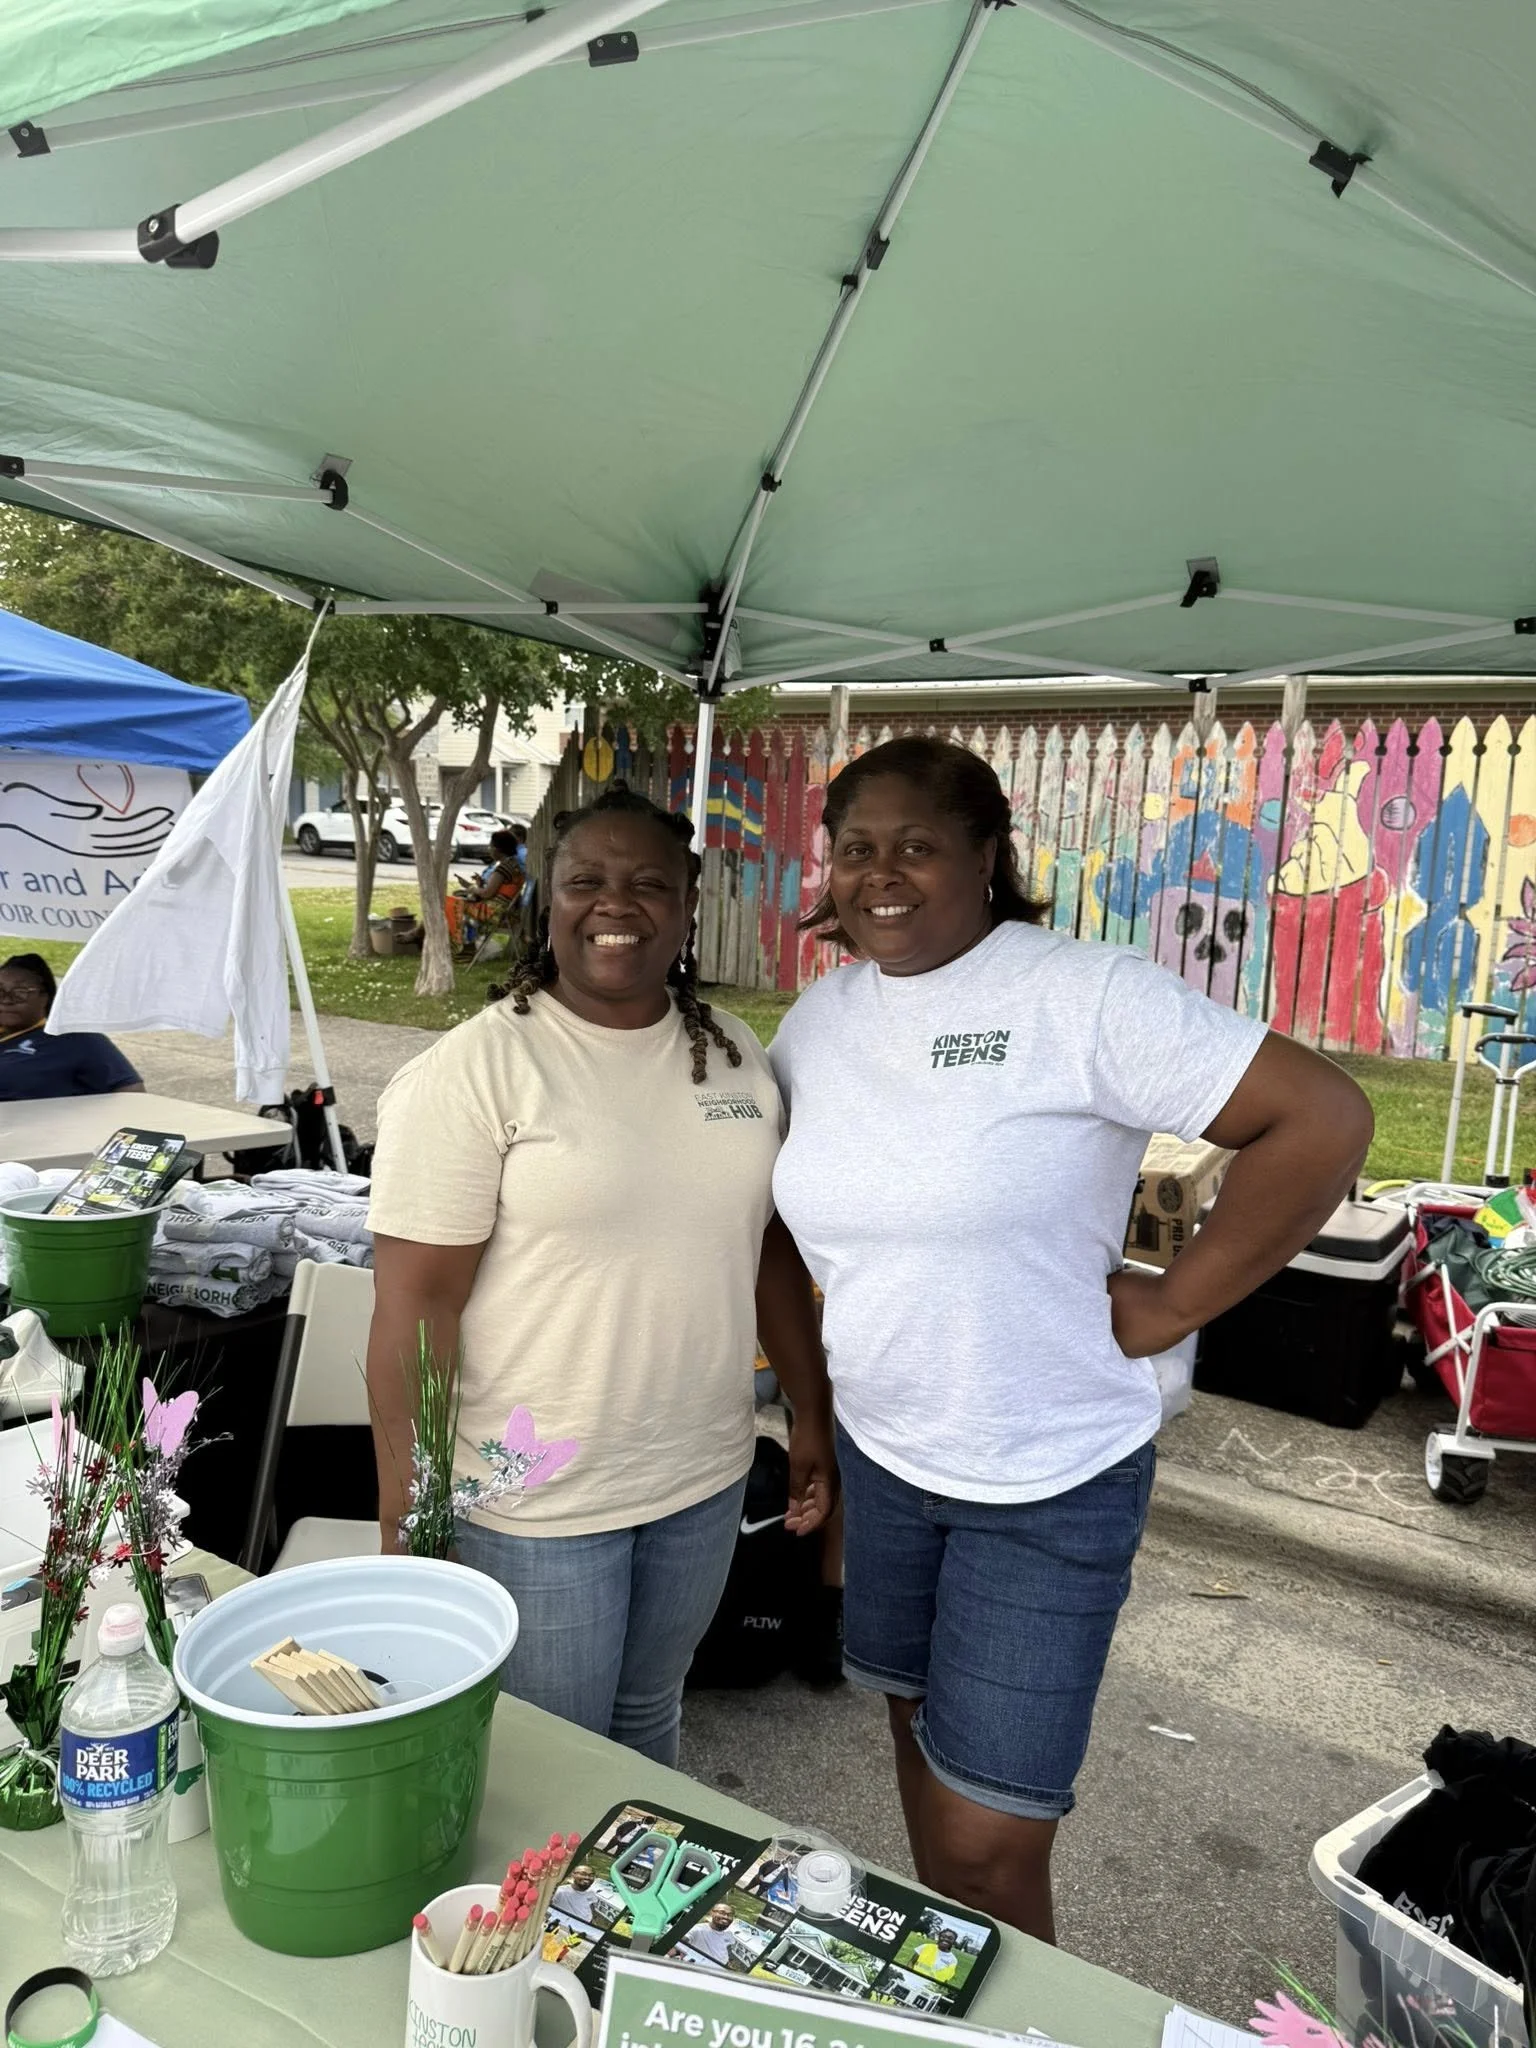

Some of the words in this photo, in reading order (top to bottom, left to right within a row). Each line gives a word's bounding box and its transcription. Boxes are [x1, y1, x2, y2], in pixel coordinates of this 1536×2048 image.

[23, 868, 87, 896] and
[932, 1029, 1011, 1050] KINSTON
[930, 1043, 1008, 1069] TEENS
[729, 1104, 763, 1119] HUB
[125, 1149, 155, 1163] TEENS
[743, 1616, 784, 1630] PLTW
[76, 1749, 129, 1766] DEER
[76, 1763, 130, 1782] PARK
[644, 2001, 704, 2037] Are
[709, 2017, 773, 2048] you
